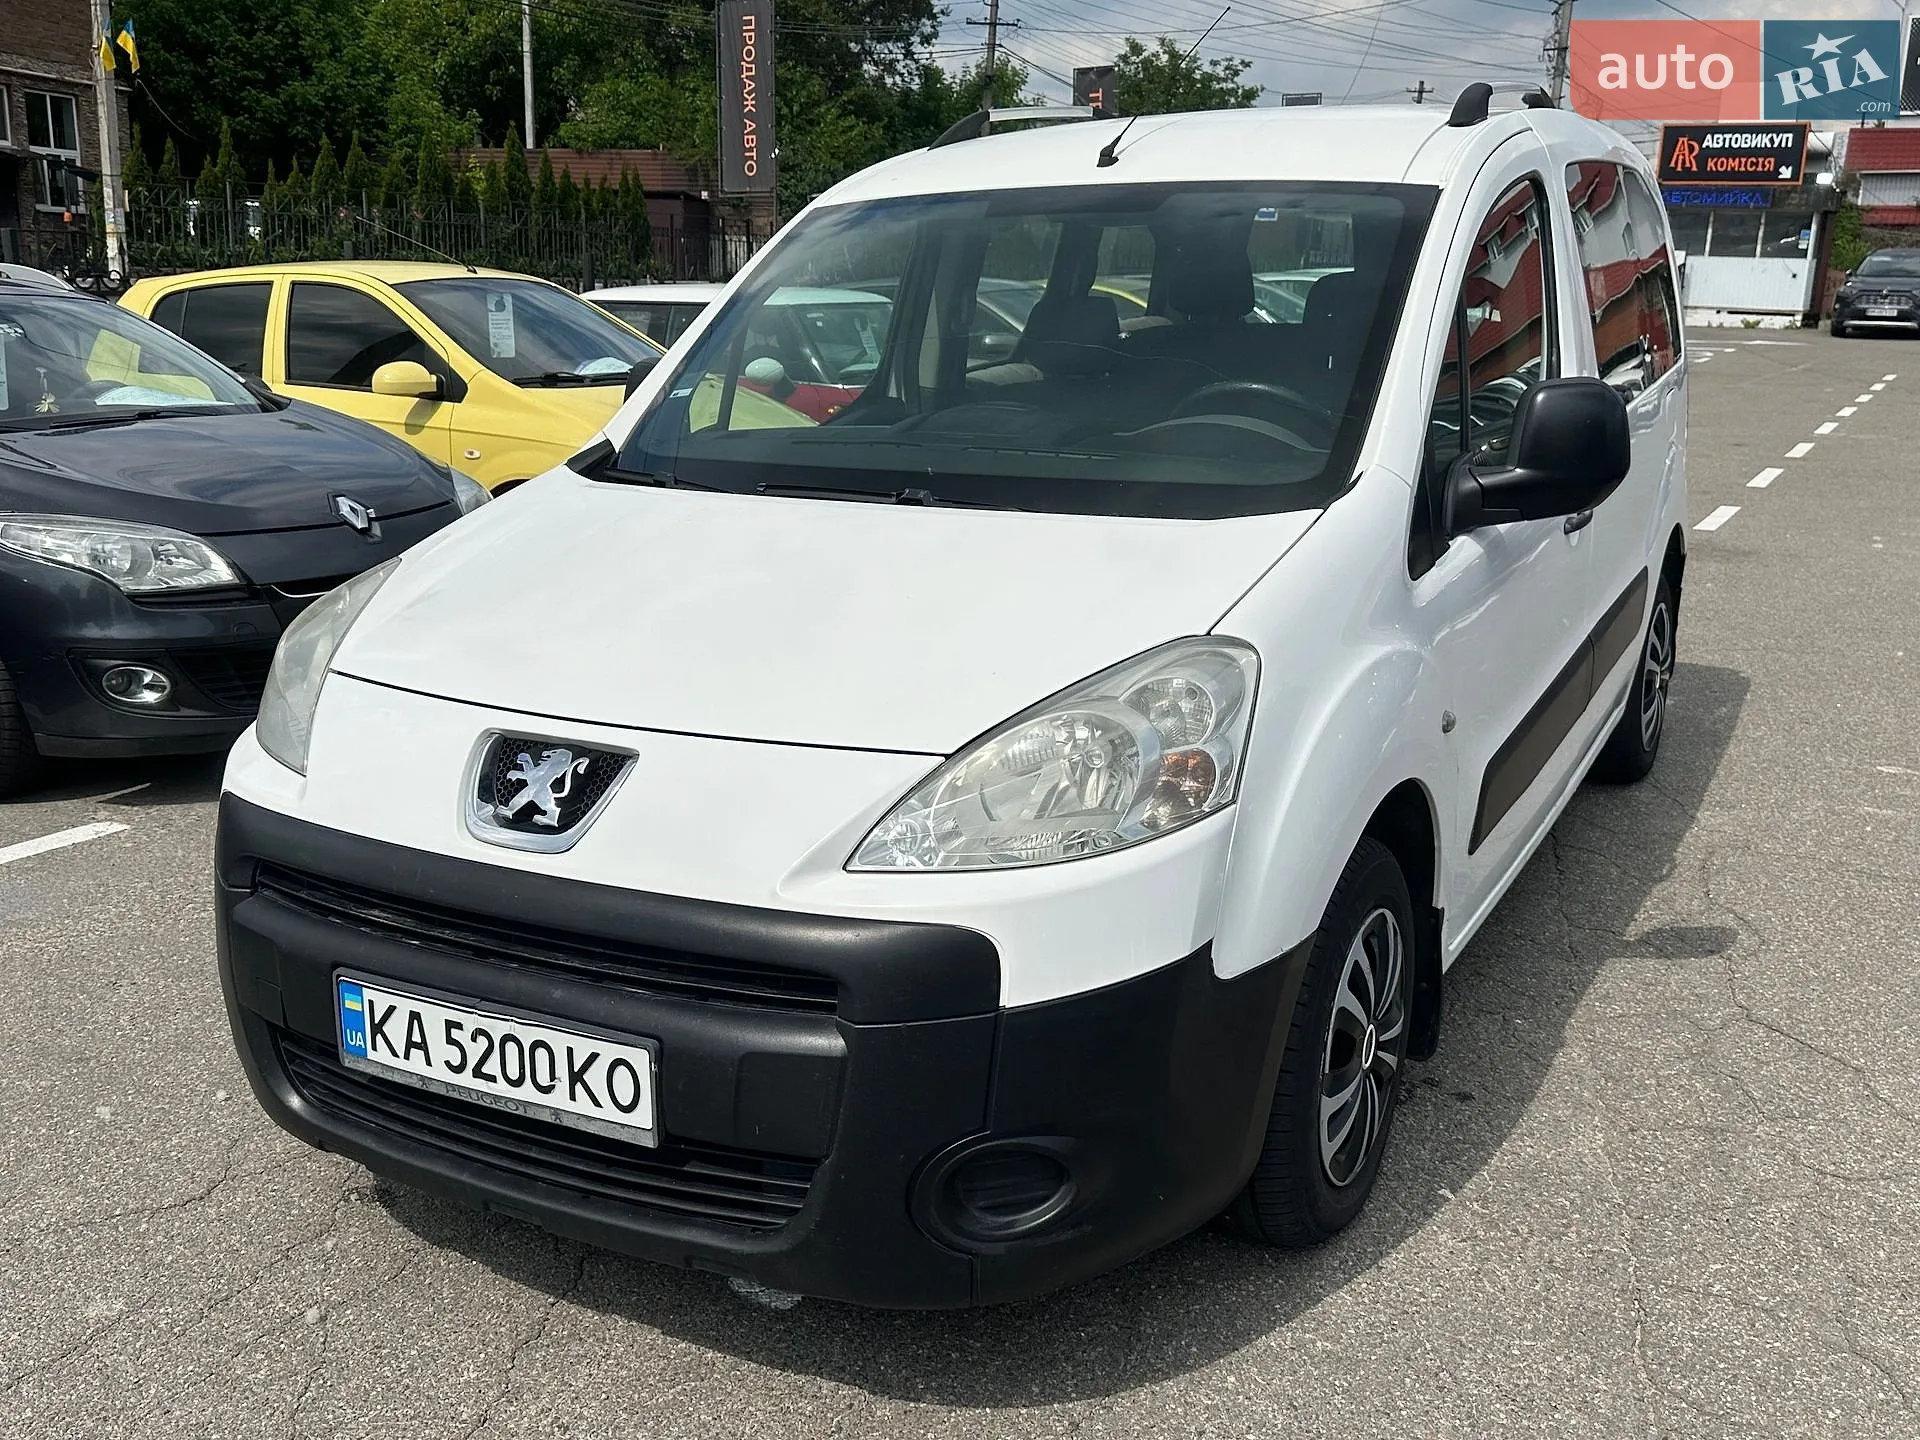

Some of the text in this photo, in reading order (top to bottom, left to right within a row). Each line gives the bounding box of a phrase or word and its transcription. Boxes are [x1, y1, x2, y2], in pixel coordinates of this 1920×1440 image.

[741, 15, 757, 177] ПРОДАЖ АВТО
[1702, 133, 1793, 149] АВТОВИКУП
[1707, 157, 1775, 172] КОМІСІЯ
[346, 1029, 366, 1048] UA
[367, 999, 642, 1114] KA 5200 KO
[445, 1084, 529, 1114] PEUGEOT
